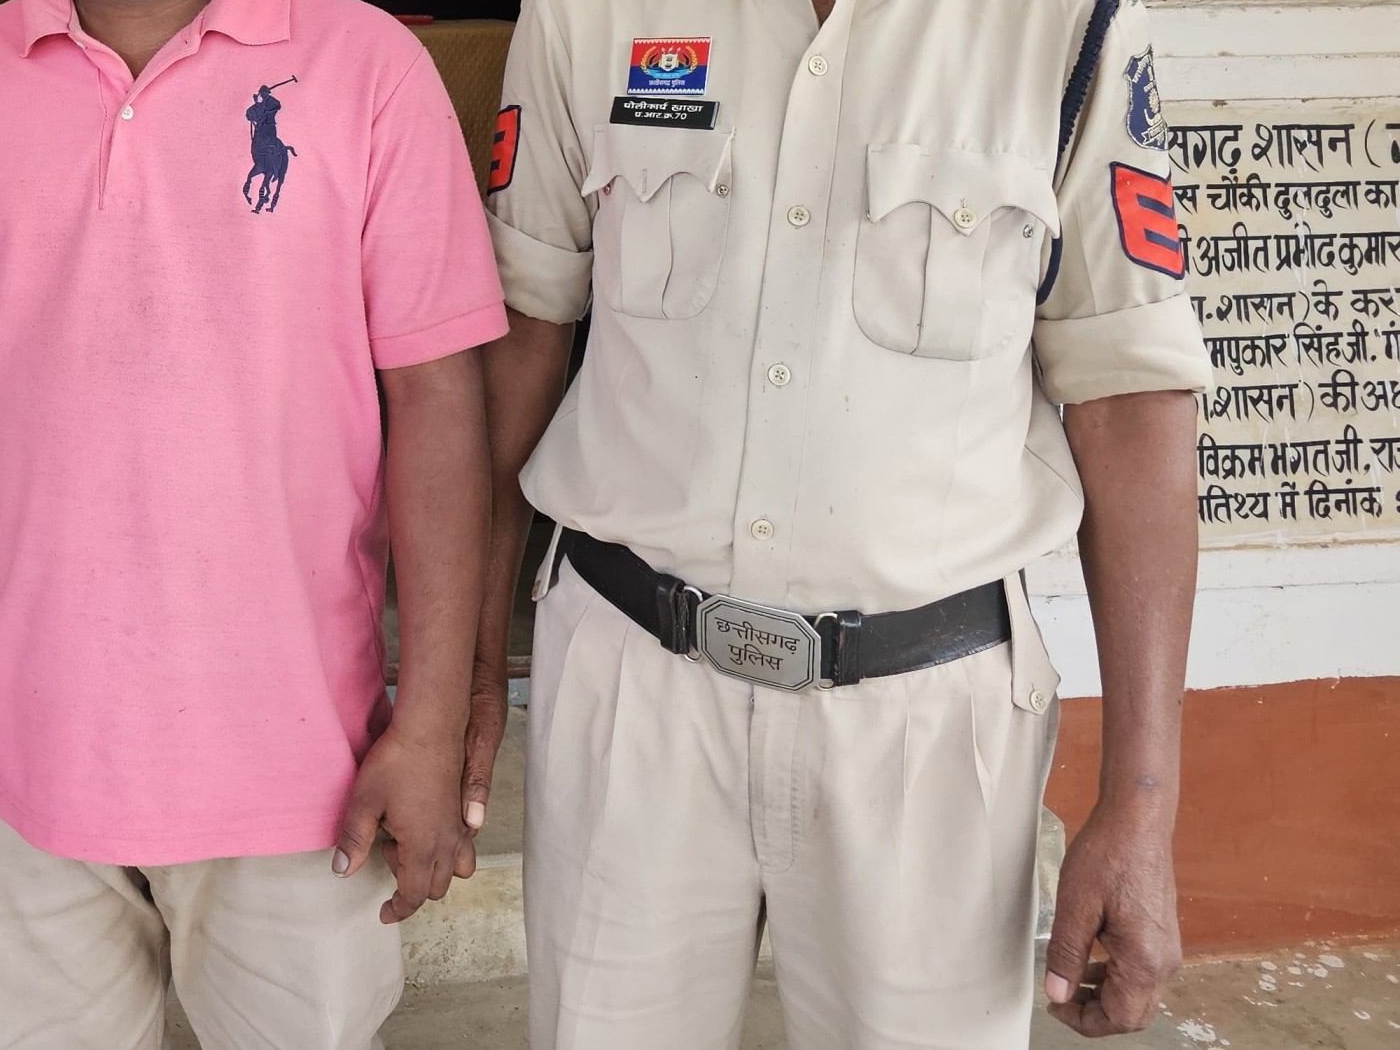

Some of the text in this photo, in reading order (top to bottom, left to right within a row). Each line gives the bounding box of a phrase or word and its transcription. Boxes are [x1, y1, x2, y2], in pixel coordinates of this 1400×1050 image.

[1251, 123, 1355, 173] शासन
[1364, 180, 1399, 208] का
[1192, 221, 1272, 277] अजीत
[1317, 368, 1359, 414] की
[1303, 478, 1384, 521] दिनांक
[715, 617, 800, 655] छत्तीसगढ़
[727, 644, 783, 670] पुलिस
